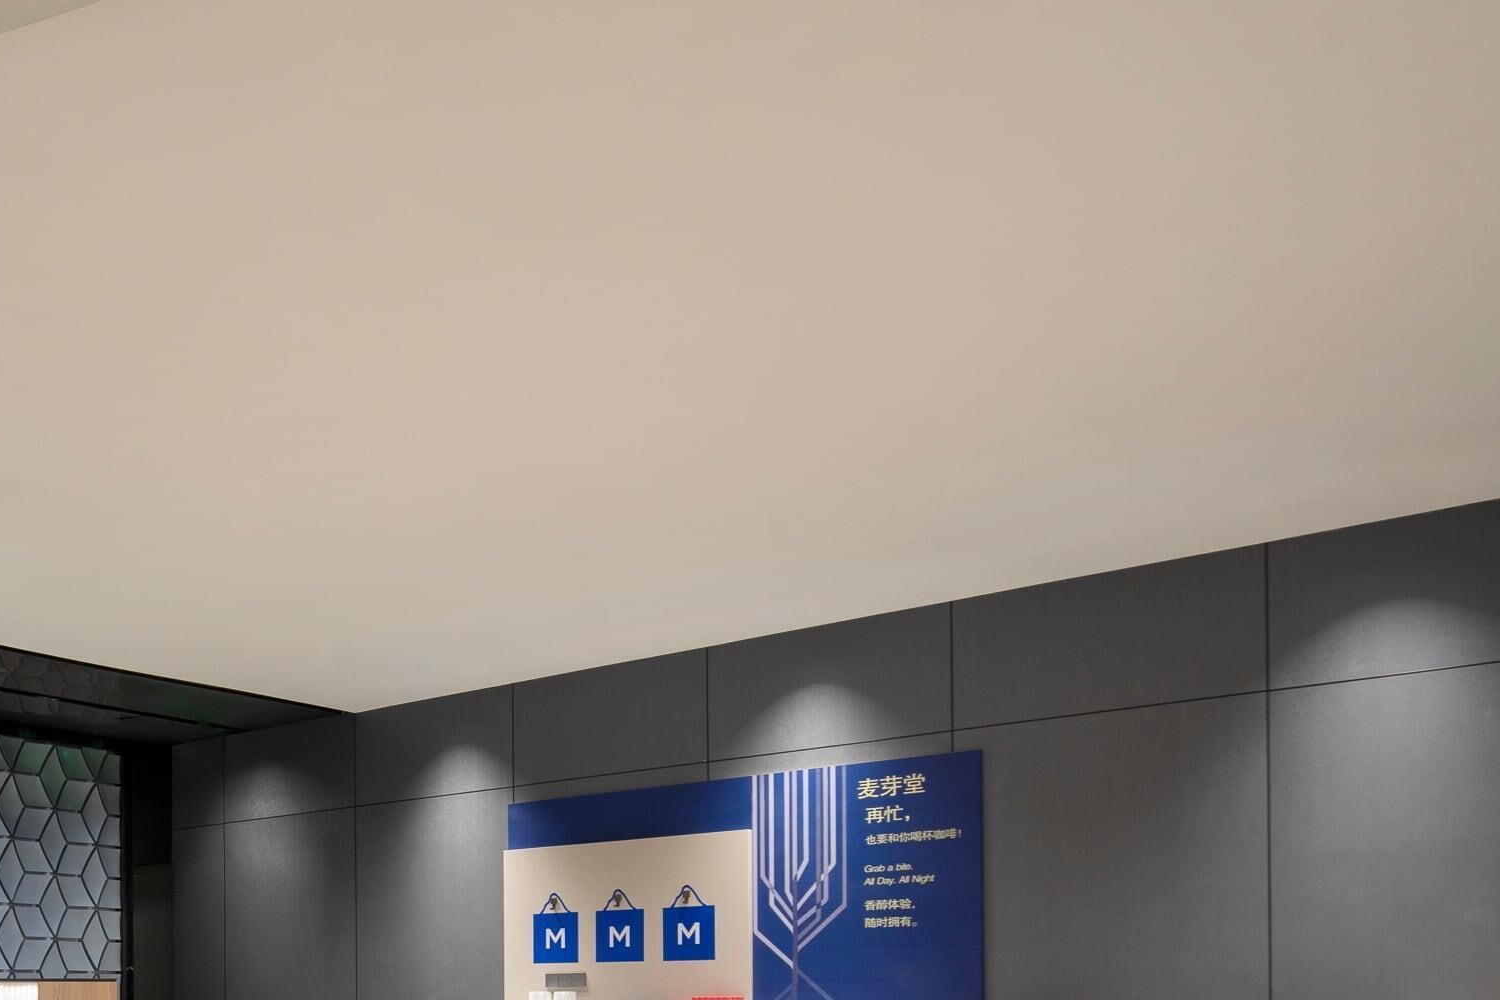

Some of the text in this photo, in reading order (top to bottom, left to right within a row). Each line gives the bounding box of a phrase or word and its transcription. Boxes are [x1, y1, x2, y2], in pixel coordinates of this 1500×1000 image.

[857, 773, 926, 800] 麦芽堂
[864, 865, 885, 873] Grab
[864, 877, 874, 885] All
[912, 875, 935, 884] Night
[545, 928, 566, 949] M
[609, 925, 630, 948] M
[677, 922, 700, 945] M
